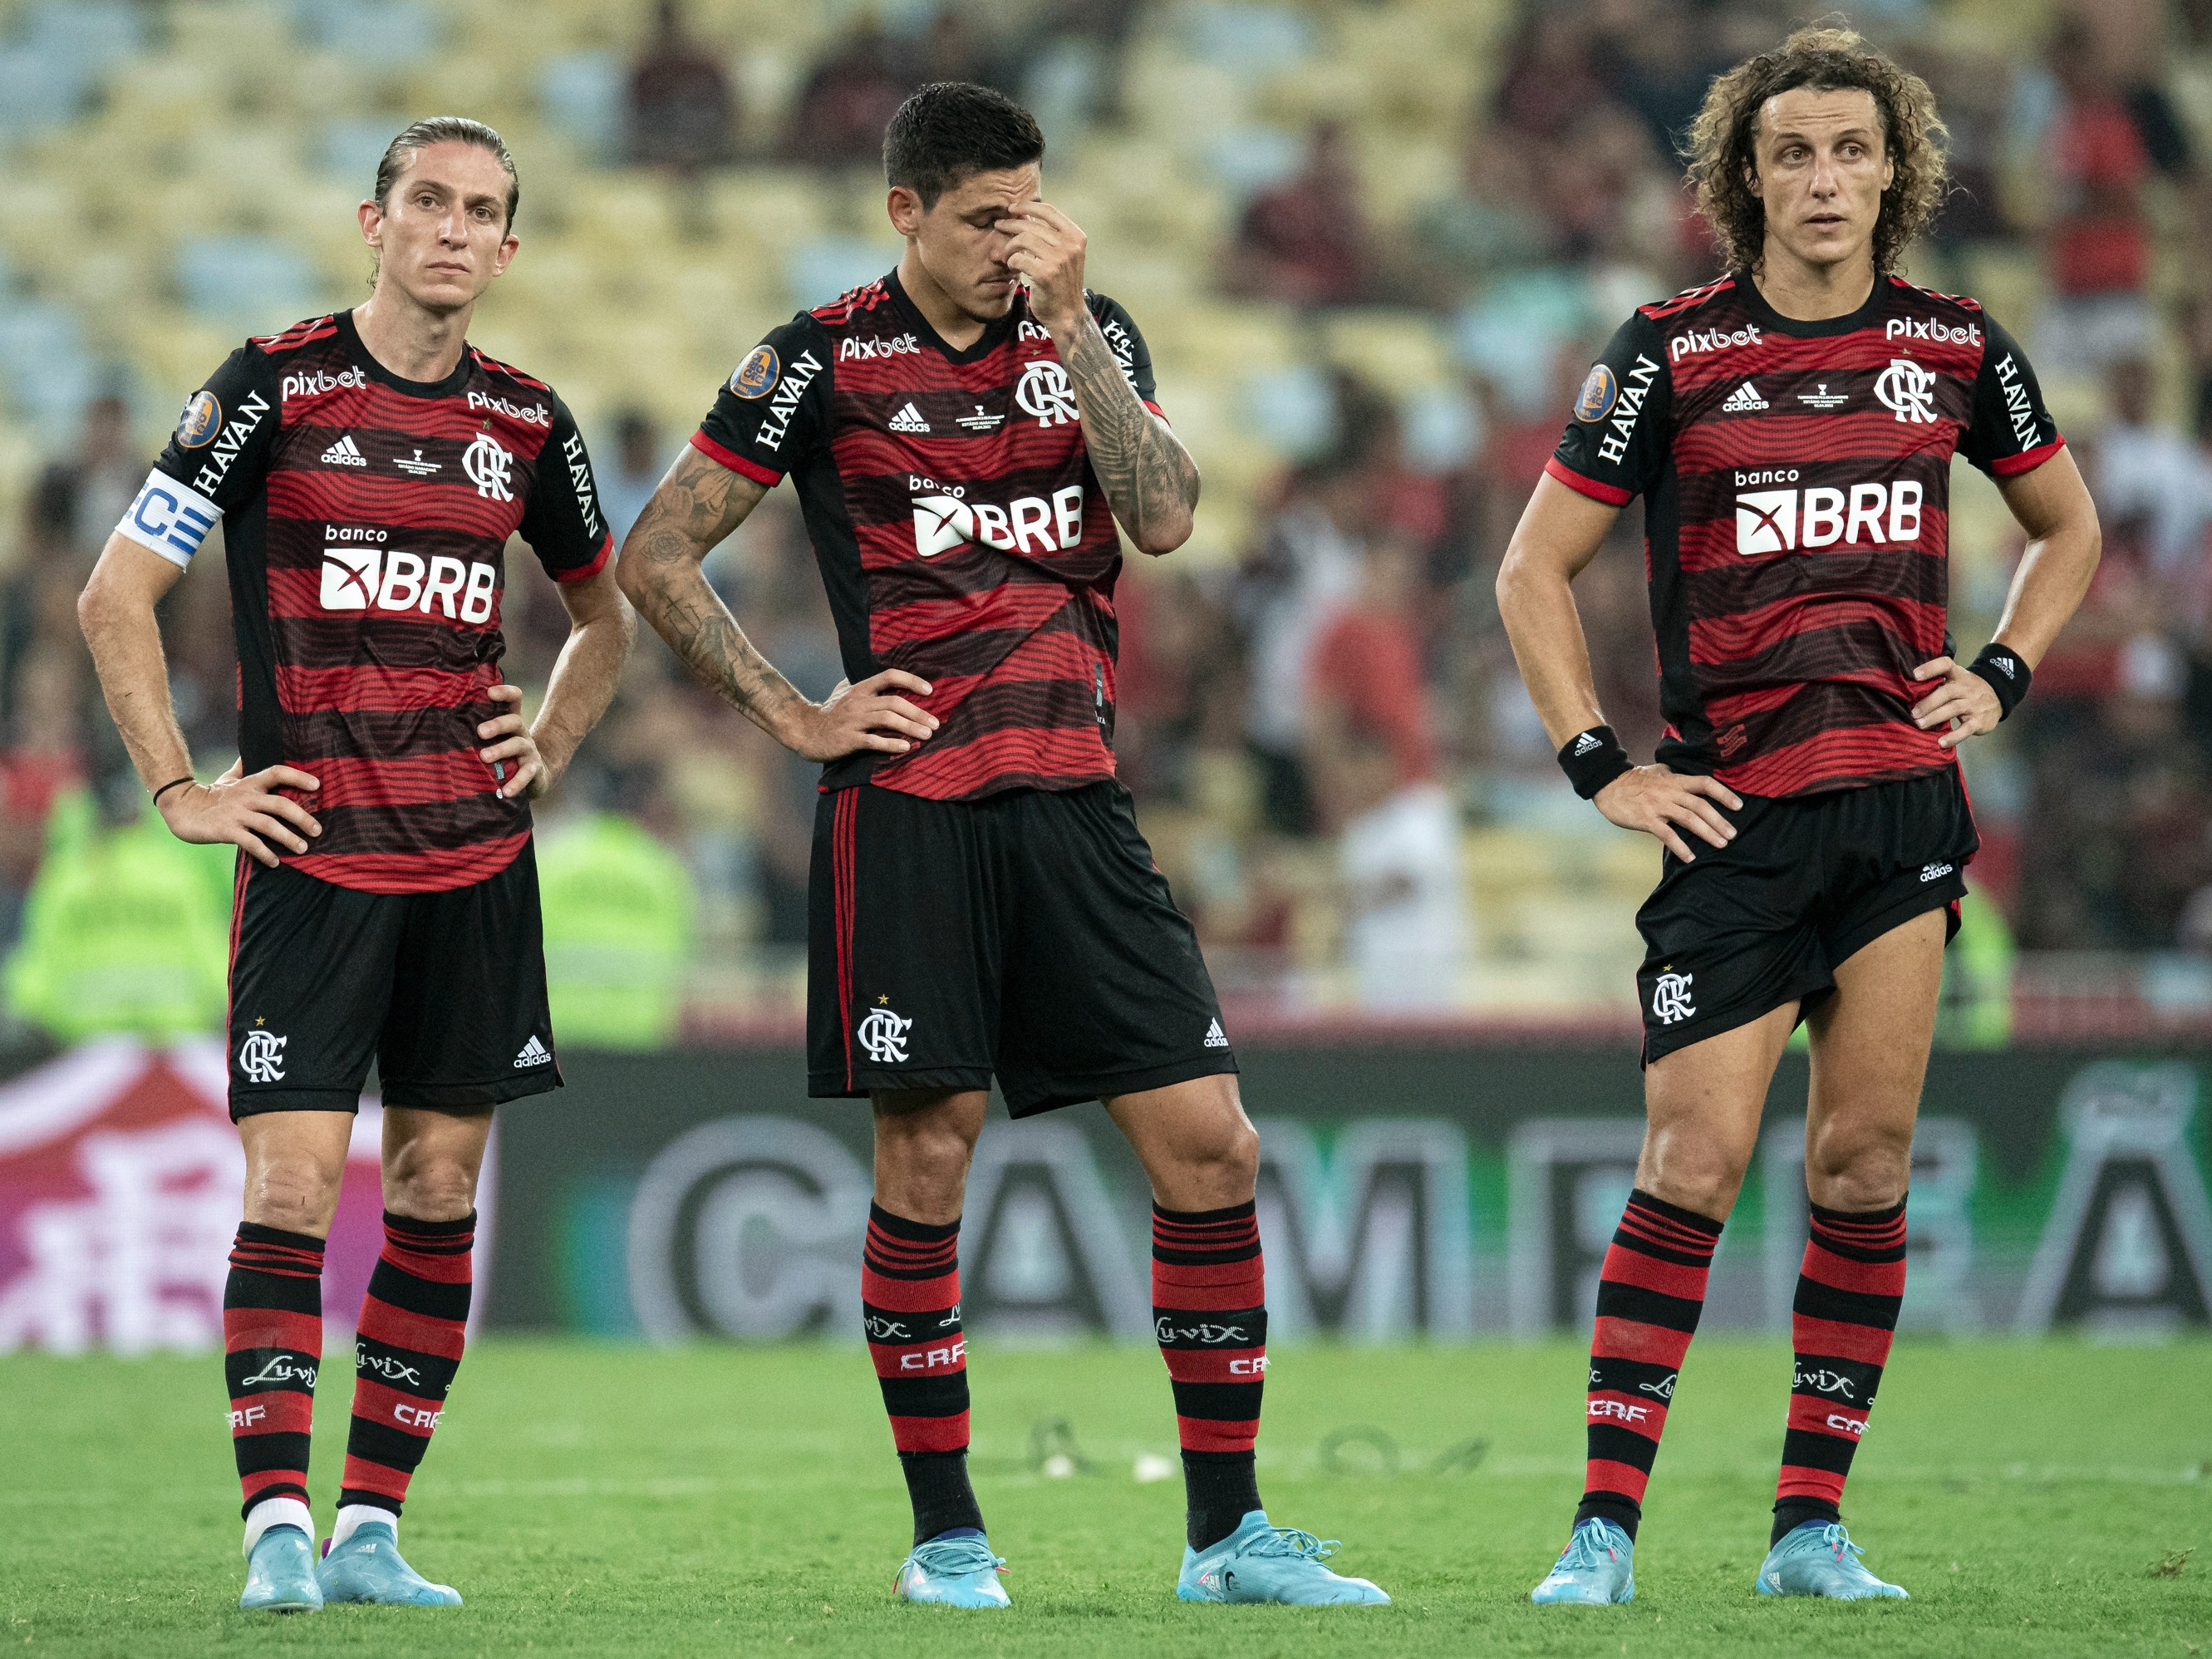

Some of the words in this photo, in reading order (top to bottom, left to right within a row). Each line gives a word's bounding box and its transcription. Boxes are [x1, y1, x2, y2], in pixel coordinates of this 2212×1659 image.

[840, 332, 920, 362] pixbet
[1672, 323, 1762, 362] pixbet
[1886, 316, 1981, 347] pixbet
[283, 365, 366, 402] pixbet
[468, 391, 549, 428] pixbet
[755, 349, 823, 452] HAVAN
[1597, 353, 1660, 465] HAVAN
[1723, 397, 1769, 411] adidas
[1995, 352, 2041, 451] HAVAN
[889, 419, 931, 433] adidas
[193, 390, 271, 497] HAVAN
[321, 452, 366, 467] adidas
[563, 431, 599, 539] HAVAN
[1735, 470, 1799, 487] banco
[971, 485, 1084, 554] BRB
[1802, 480, 1923, 548] BRB
[325, 524, 387, 543] banco
[376, 551, 496, 624] BRB
[1989, 657, 2014, 680] adidas
[1575, 740, 1603, 756] adidas
[1920, 862, 1953, 883] adidas
[1204, 1036, 1229, 1047] adidas
[514, 1050, 552, 1069] adidas
